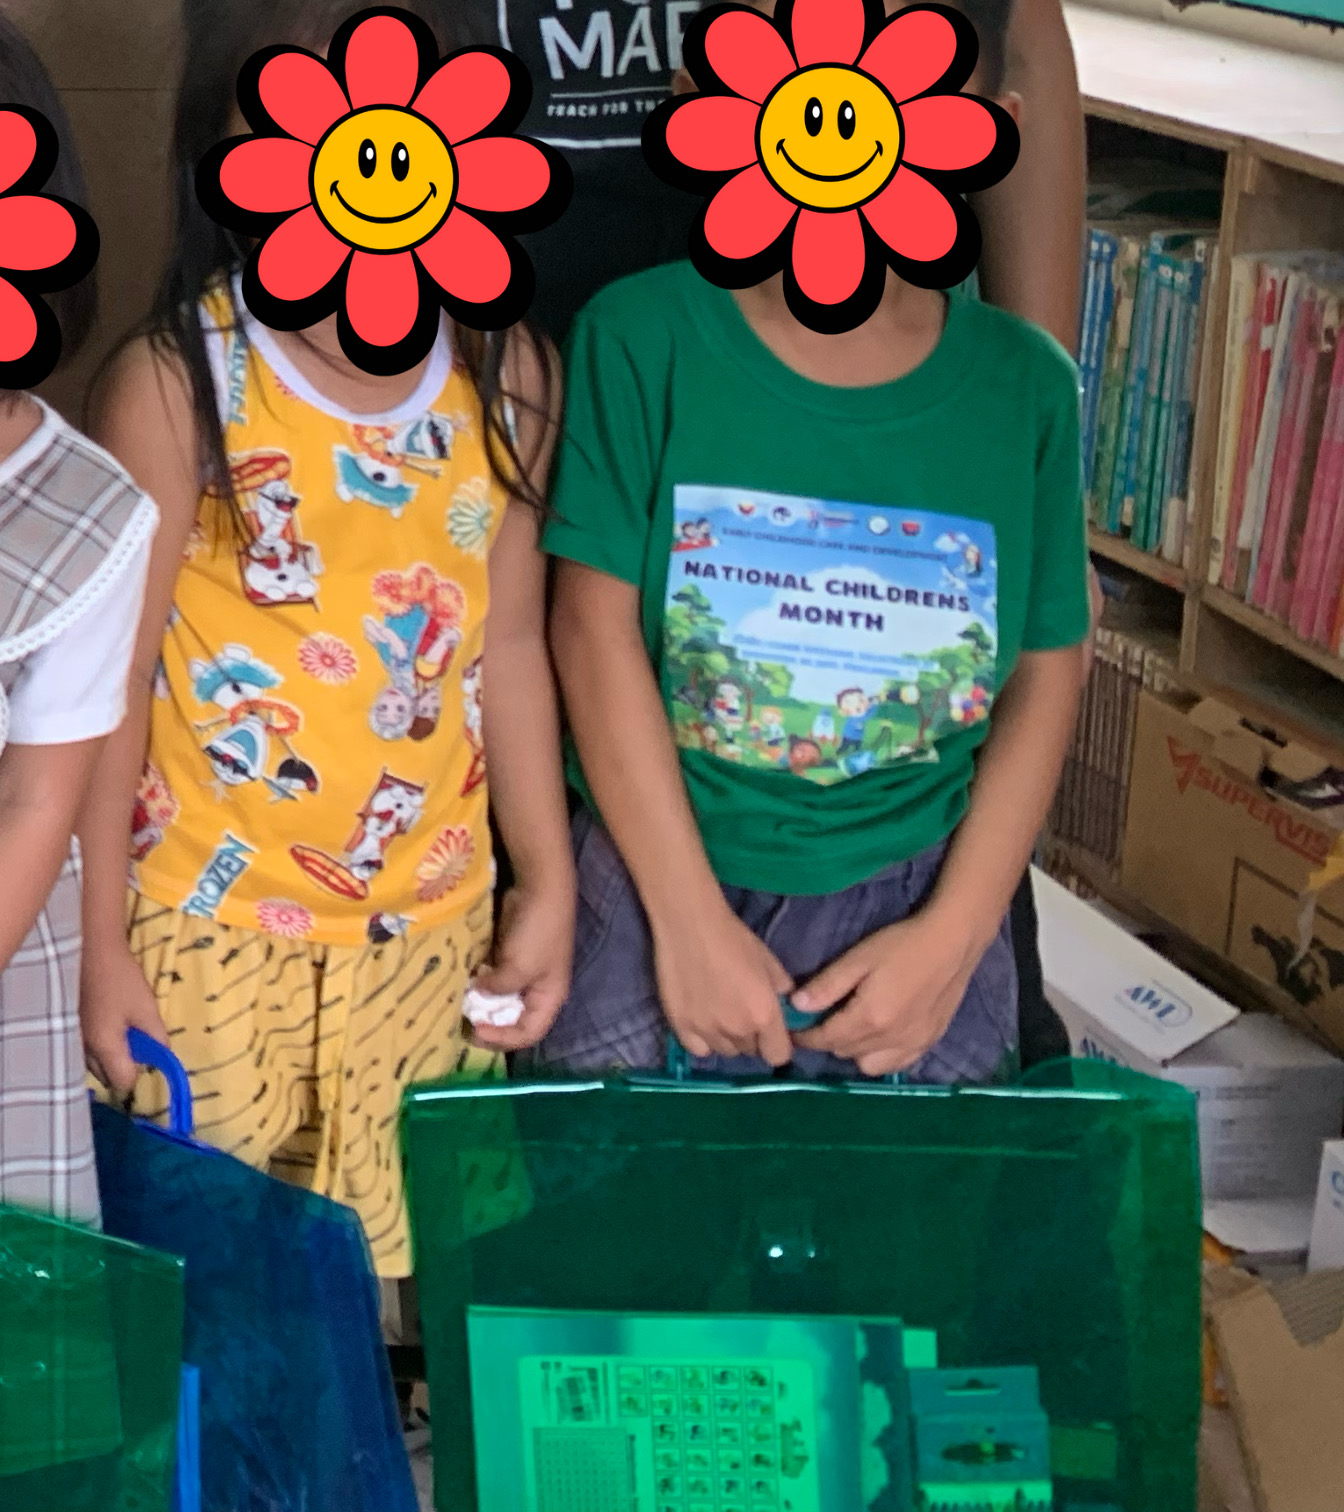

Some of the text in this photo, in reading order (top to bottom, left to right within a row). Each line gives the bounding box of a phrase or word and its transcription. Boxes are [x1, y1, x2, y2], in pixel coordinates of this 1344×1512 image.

[683, 560, 971, 613] NATIONAL CHILDRENS
[778, 602, 885, 632] MONTH
